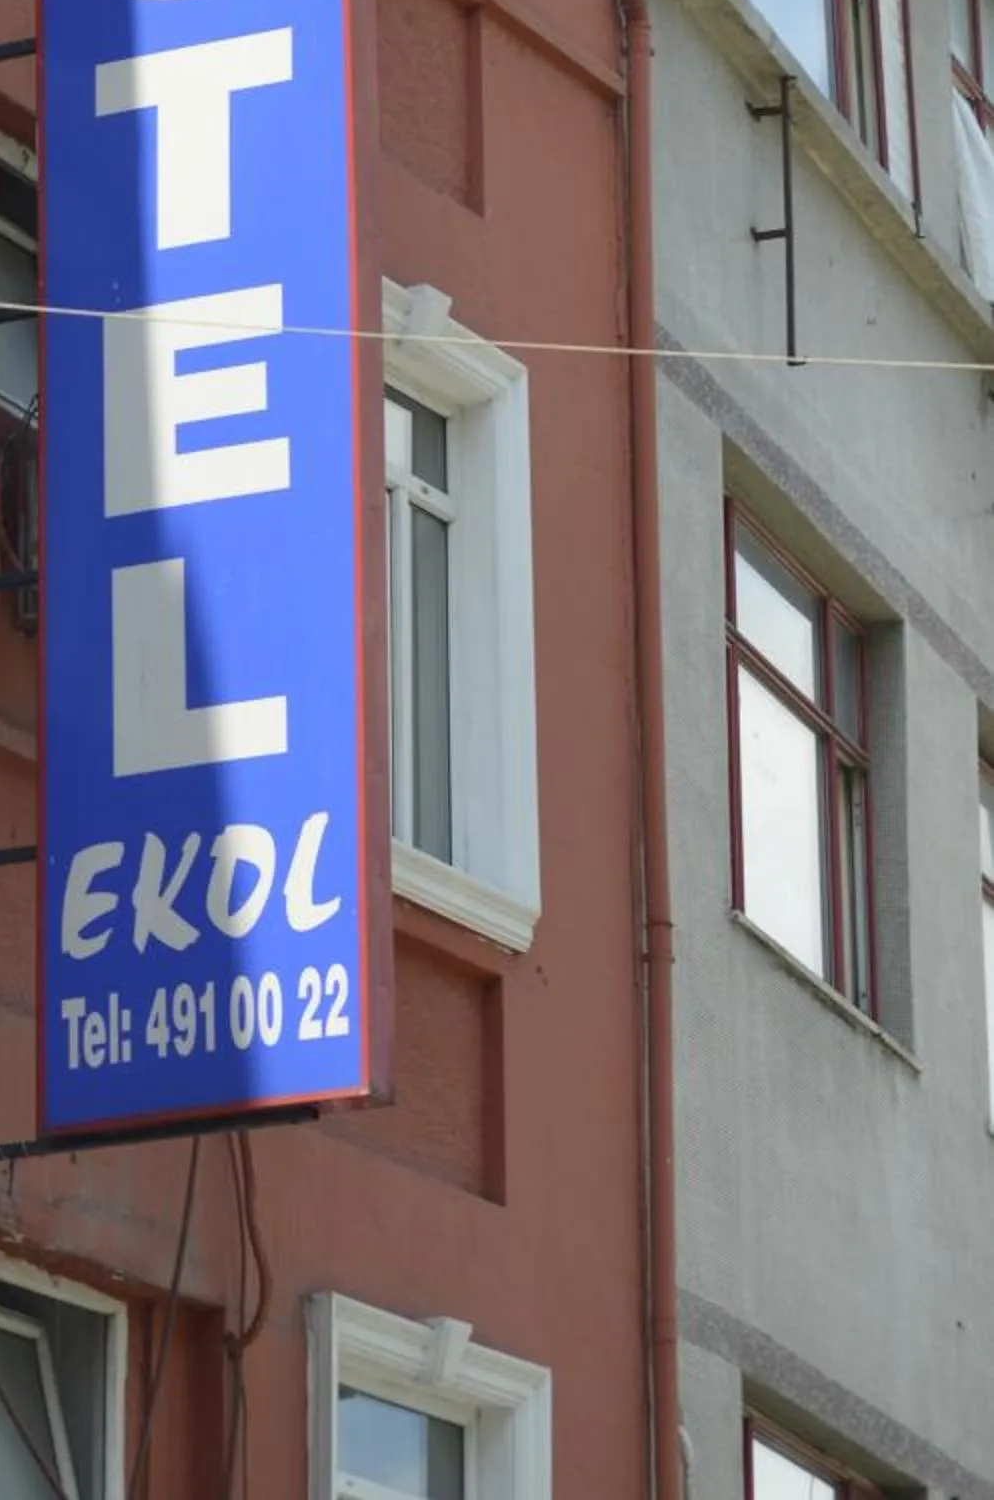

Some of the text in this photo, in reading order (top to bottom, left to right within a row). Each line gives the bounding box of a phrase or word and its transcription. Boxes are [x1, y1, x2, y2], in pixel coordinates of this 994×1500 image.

[61, 811, 341, 959] EKOL
[61, 963, 349, 1069] Tel: 491 00 22
